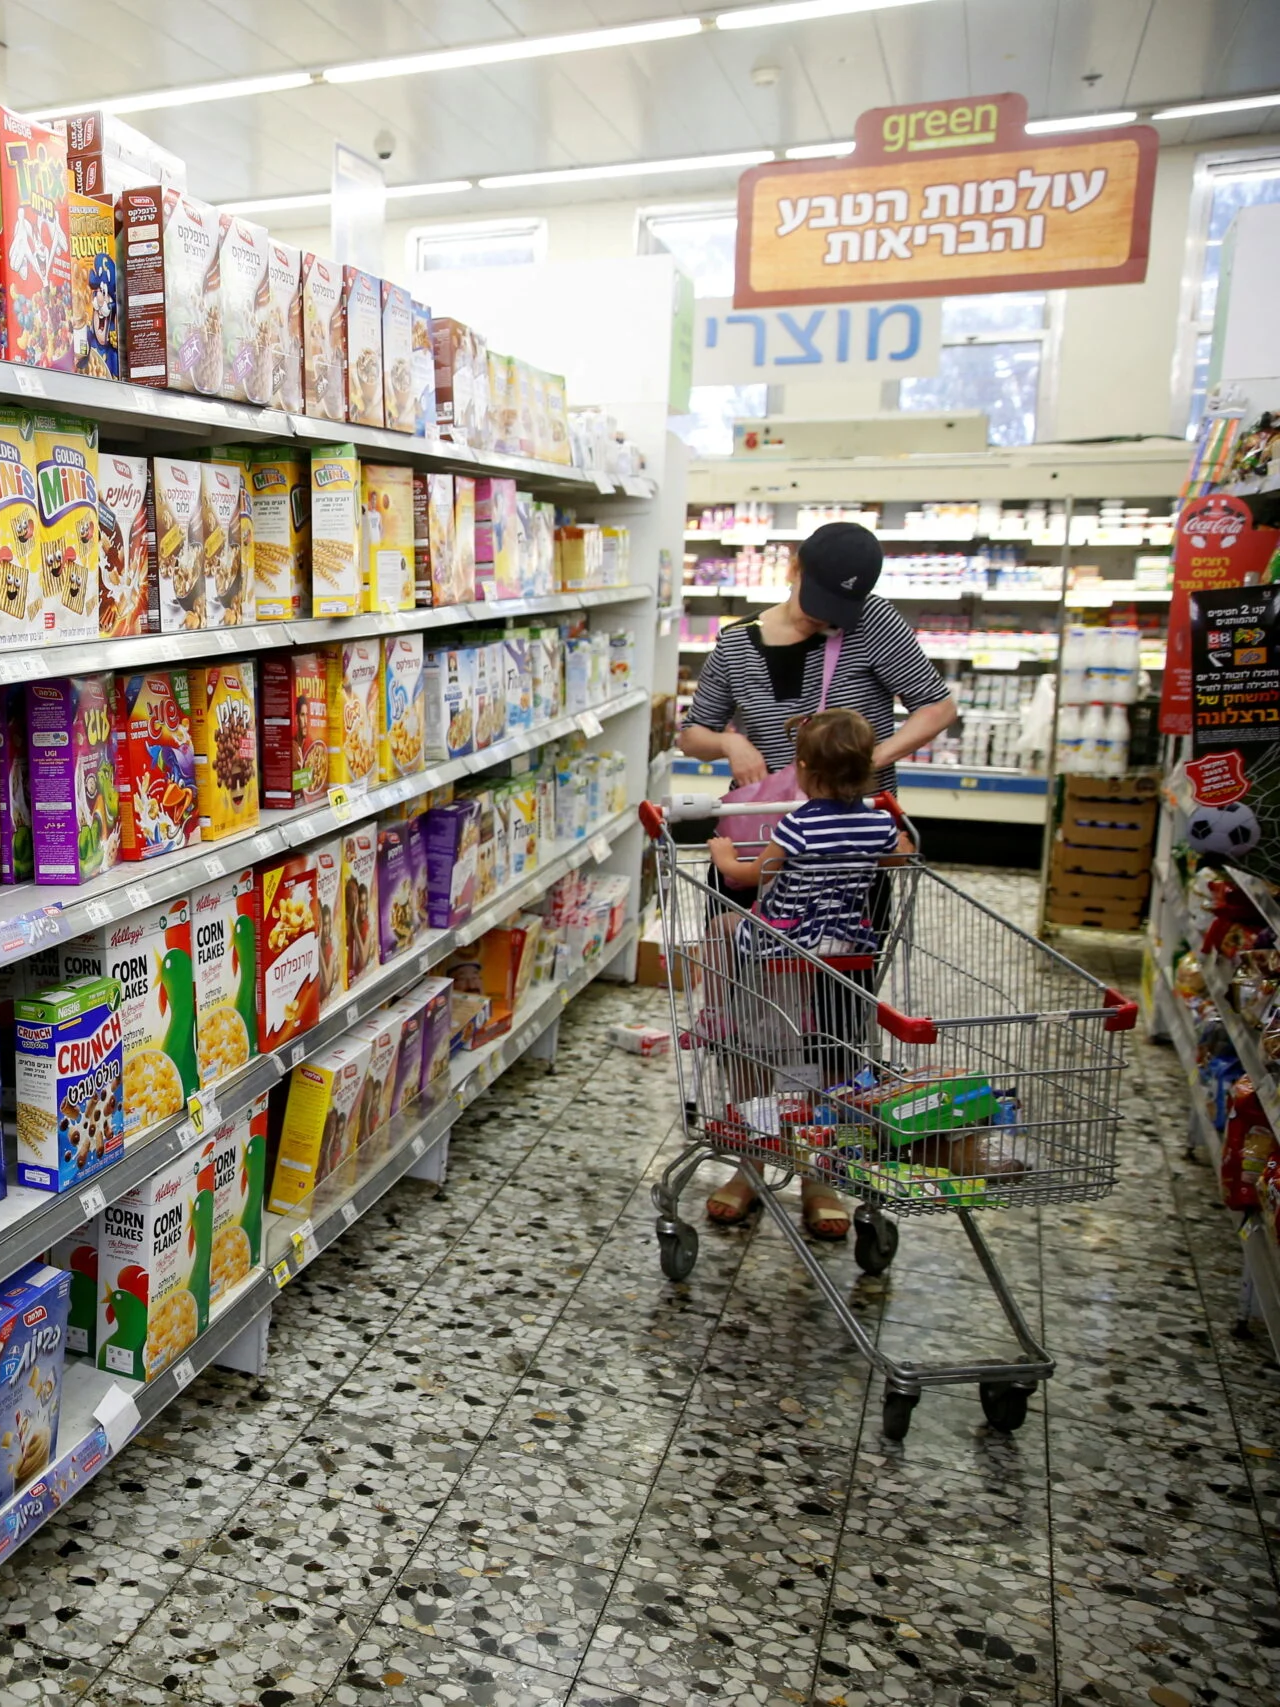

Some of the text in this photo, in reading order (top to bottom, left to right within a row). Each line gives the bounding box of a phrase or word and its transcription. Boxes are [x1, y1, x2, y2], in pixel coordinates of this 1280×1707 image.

[883, 104, 998, 153] green
[6, 141, 66, 206] Trix
[776, 169, 1107, 236] עולמות הטבע
[178, 224, 210, 248] ברנפלקס
[824, 214, 1045, 265] והבריאות
[231, 245, 261, 267] ברנפלקס
[705, 304, 922, 367] מוצרי
[55, 448, 85, 465] GOLDEN
[1183, 516, 1246, 534] Coca-Cola
[1241, 605, 1250, 615] 2
[1196, 689, 1279, 707] למשחק של
[1196, 707, 1280, 726] ברצלונה
[195, 895, 222, 913] Kellogg's
[111, 926, 144, 947] Kellogg's
[197, 919, 224, 947] CORN
[112, 954, 148, 978] CORN
[198, 942, 224, 966] FLAKES
[273, 950, 313, 982] קורנפלקס
[64, 957, 102, 979] CORN
[57, 1004, 80, 1019] Nestlé
[18, 1026, 52, 1041] CRUNCH
[58, 1012, 122, 1075] CRUNCH
[68, 1072, 99, 1105] נוגט
[154, 1176, 182, 1203] Kellogg's
[104, 1206, 144, 1231] CORN
[152, 1202, 182, 1238] CORN
[104, 1223, 144, 1243] FLAKES
[152, 1225, 182, 1257] FLAKES
[27, 1308, 43, 1323] תלמה
